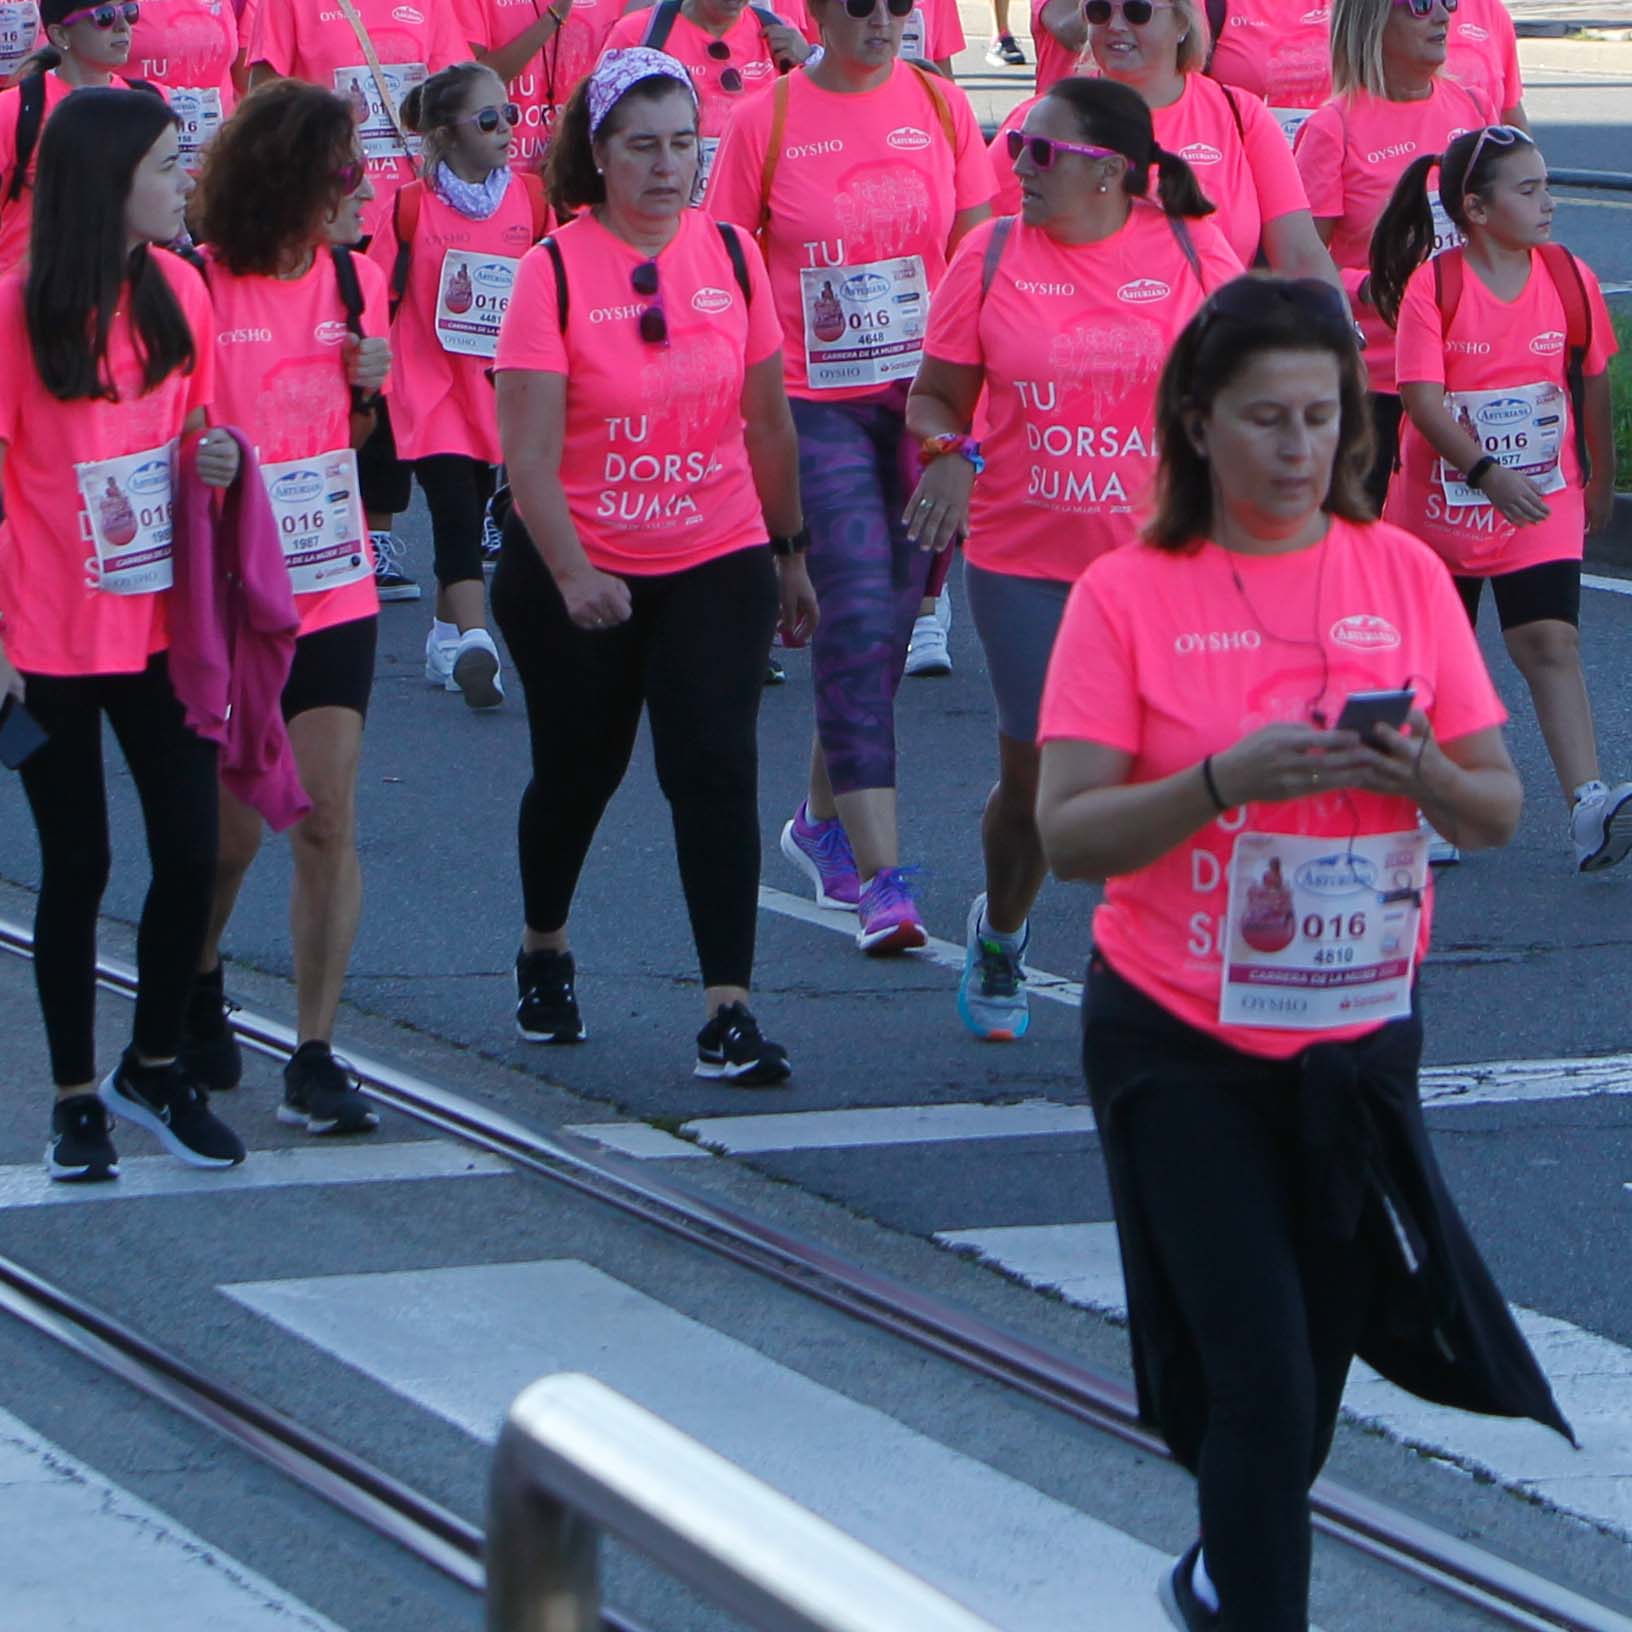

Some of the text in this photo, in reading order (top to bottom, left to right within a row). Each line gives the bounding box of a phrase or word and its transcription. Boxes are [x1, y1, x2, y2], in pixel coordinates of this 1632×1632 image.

[141, 58, 168, 78] TU
[786, 138, 844, 160] OYSHO
[1367, 140, 1416, 166] OYSHO
[803, 239, 845, 268] TU
[1015, 279, 1075, 296] OYSHO
[1122, 287, 1167, 299] ASTURIANA
[475, 294, 509, 313] 016
[849, 310, 891, 330] 016
[858, 331, 885, 345] 4648
[822, 349, 857, 361] CARRERA
[820, 367, 861, 380] OYSHO
[1013, 381, 1057, 411] TU
[1482, 408, 1529, 422] ASTURIANA
[605, 415, 647, 443] TU
[1485, 432, 1528, 452] 016
[1028, 465, 1128, 503] SUMA
[282, 510, 324, 534] 016
[293, 535, 320, 550] 1987
[1175, 629, 1262, 654] OYSHO
[1303, 911, 1367, 939] 016
[1314, 947, 1354, 964] 4810
[1249, 968, 1309, 984] CARRERA
[1242, 995, 1308, 1013] OYSHO
